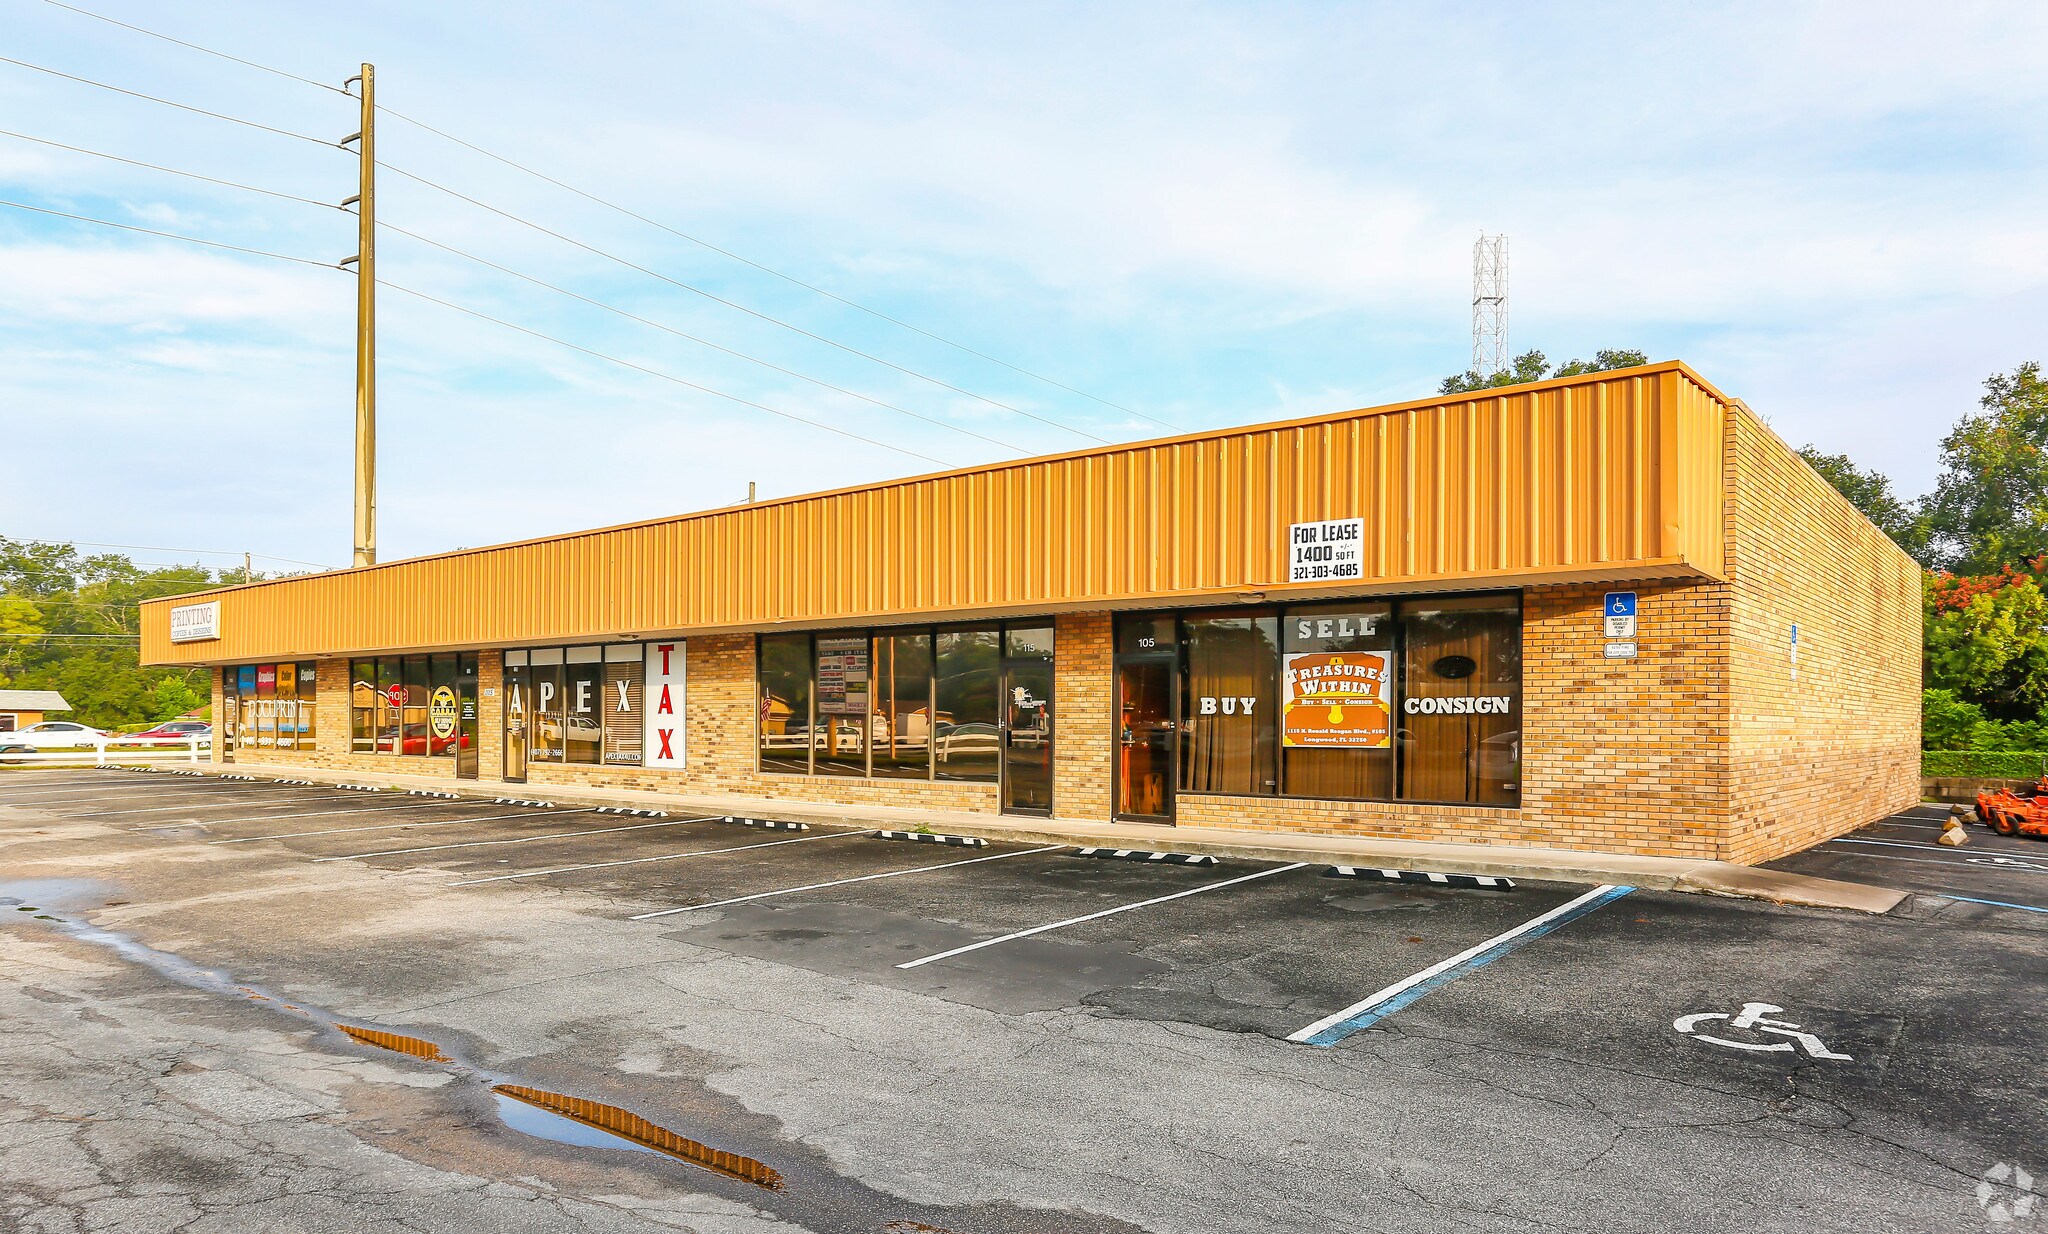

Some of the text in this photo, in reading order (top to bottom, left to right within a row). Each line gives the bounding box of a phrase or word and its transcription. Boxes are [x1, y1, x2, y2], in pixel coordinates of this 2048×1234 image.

[1294, 524, 1358, 544] FOR LEASE
[1296, 545, 1333, 563] 1400
[1294, 563, 1358, 579] 321-303-4685
[172, 607, 212, 627] PRINTING
[172, 629, 187, 637] COPIES
[193, 627, 212, 635] DESIGNS
[1298, 617, 1376, 639] SELL
[1023, 643, 1036, 652] 115
[1138, 638, 1155, 648] 105
[258, 672, 275, 683] Graphics
[300, 669, 315, 681] Copies
[1287, 664, 1389, 683] TREASURES
[1300, 679, 1372, 695] WITHIN
[248, 699, 304, 718] DOCUPRINT
[657, 644, 674, 759] TAX
[1200, 697, 1256, 715] BUY
[1404, 697, 1510, 714] CONSIGN
